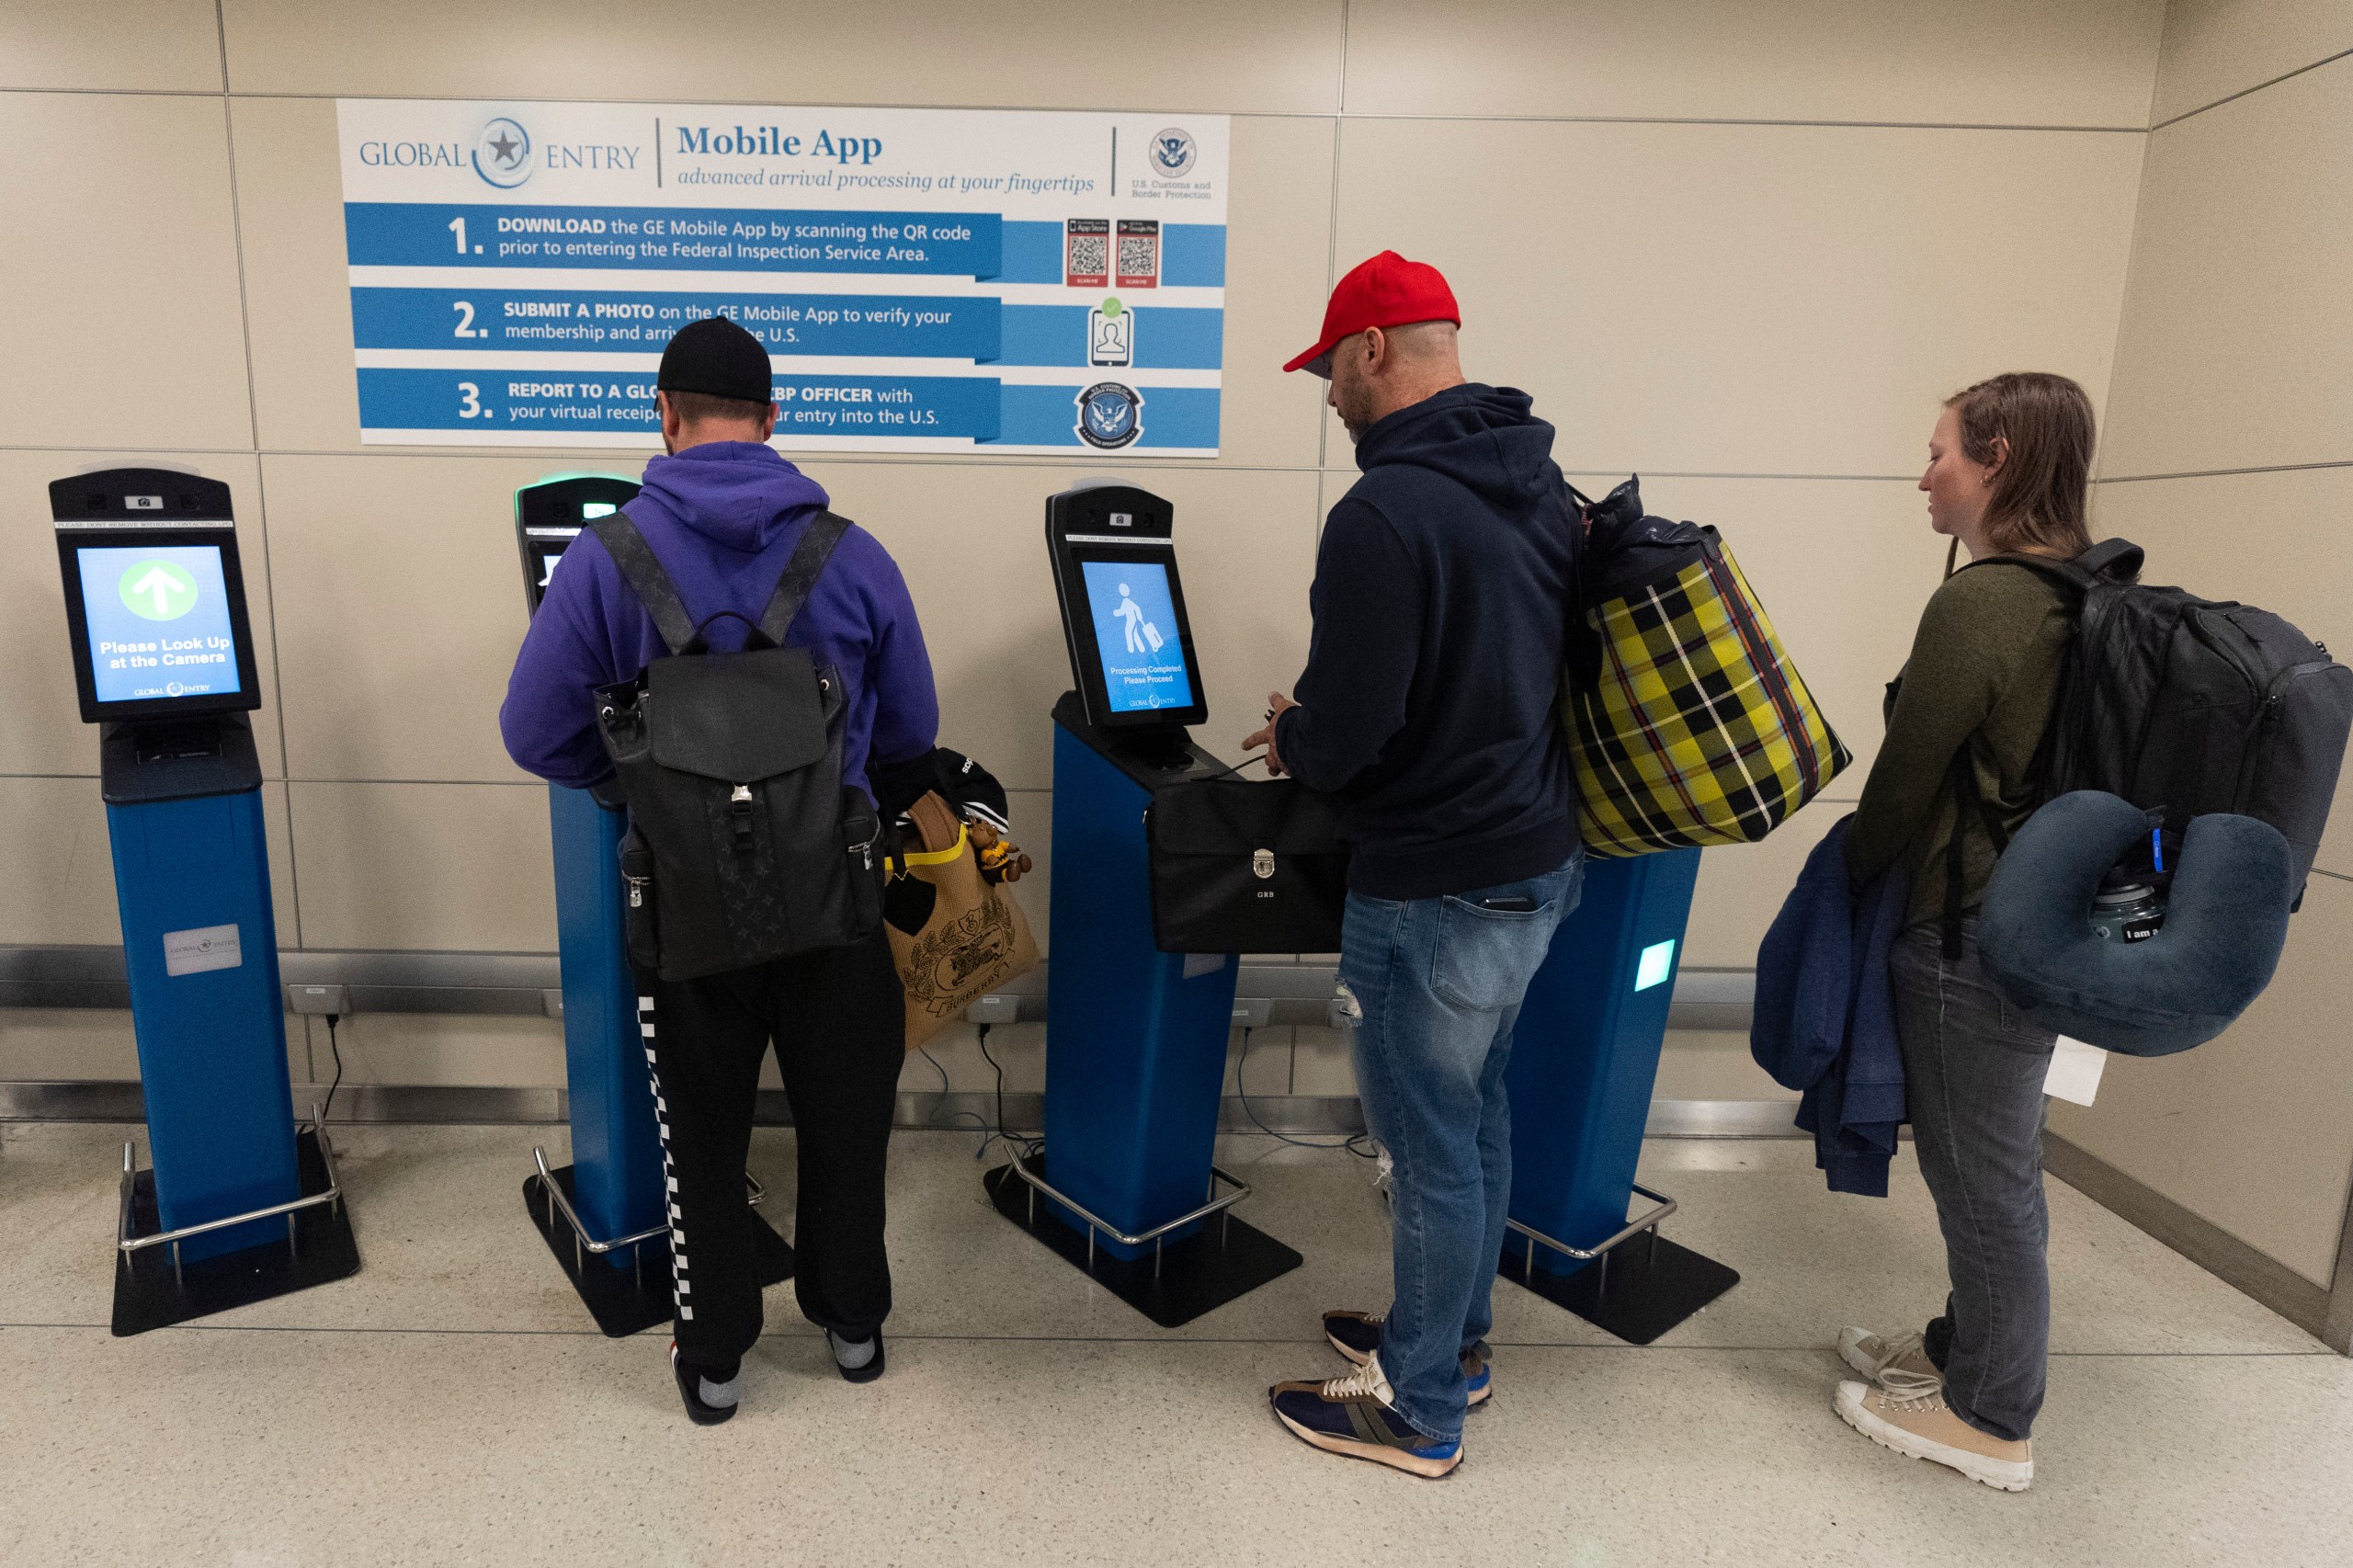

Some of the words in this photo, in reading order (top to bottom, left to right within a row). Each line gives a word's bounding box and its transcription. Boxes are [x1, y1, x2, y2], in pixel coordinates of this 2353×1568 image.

[360, 142, 466, 166] GLOBAL
[547, 145, 639, 169] ENTRY
[676, 126, 801, 155] Mobile
[812, 130, 881, 165] App
[678, 167, 764, 185] advanced
[769, 170, 833, 186] arrival
[837, 172, 932, 192] processing
[938, 176, 955, 188] at
[961, 178, 1003, 193] your
[1008, 173, 1094, 195] fingertips
[449, 218, 483, 254] 1.
[498, 219, 606, 233] DOWNLOAD
[611, 219, 638, 234] the
[643, 220, 665, 234] GE
[671, 221, 727, 235] Mobile
[733, 222, 766, 240] App
[771, 222, 790, 240] by
[795, 223, 866, 242] scanning
[871, 224, 898, 239] the
[904, 225, 927, 241] QR
[933, 225, 971, 240] code
[500, 240, 539, 257] prior
[543, 242, 561, 255] to
[566, 241, 635, 259] entering
[641, 241, 667, 256] the
[673, 243, 732, 257] Federal
[738, 244, 820, 261] Inspection
[825, 245, 881, 260] Service
[886, 246, 928, 261] Area.
[454, 301, 488, 337] 2.
[505, 302, 571, 317] SUBMIT
[577, 303, 590, 317] A
[596, 304, 654, 318] PHOTO
[660, 308, 679, 319] on
[685, 305, 711, 319] the
[745, 306, 800, 321] Mobile
[805, 308, 838, 324] App
[843, 309, 860, 322] to
[865, 308, 910, 326] verify
[915, 312, 951, 326] your
[506, 324, 605, 342] membership
[610, 325, 640, 339] and
[770, 328, 799, 342] U.S.
[459, 382, 493, 418] 3.
[509, 383, 574, 397] REPORT
[579, 384, 602, 398] TO
[608, 385, 621, 398] A
[771, 387, 796, 401] BP
[801, 388, 872, 402] OFFICER
[877, 389, 913, 403] with
[509, 407, 545, 421] your
[551, 404, 601, 418] virtual
[795, 410, 836, 426] entry
[842, 409, 873, 423] into
[878, 409, 904, 424] the
[910, 410, 938, 424] U.S.
[100, 642, 156, 653] Please
[162, 638, 203, 651] Look
[208, 637, 230, 650] Up
[110, 656, 127, 669] at
[131, 656, 158, 667] the
[162, 653, 225, 665] Camera
[1149, 665, 1181, 674] Completed
[134, 687, 164, 696] GLOBAL
[2127, 930, 2131, 938] I
[947, 968, 999, 1011] BURBERRY
